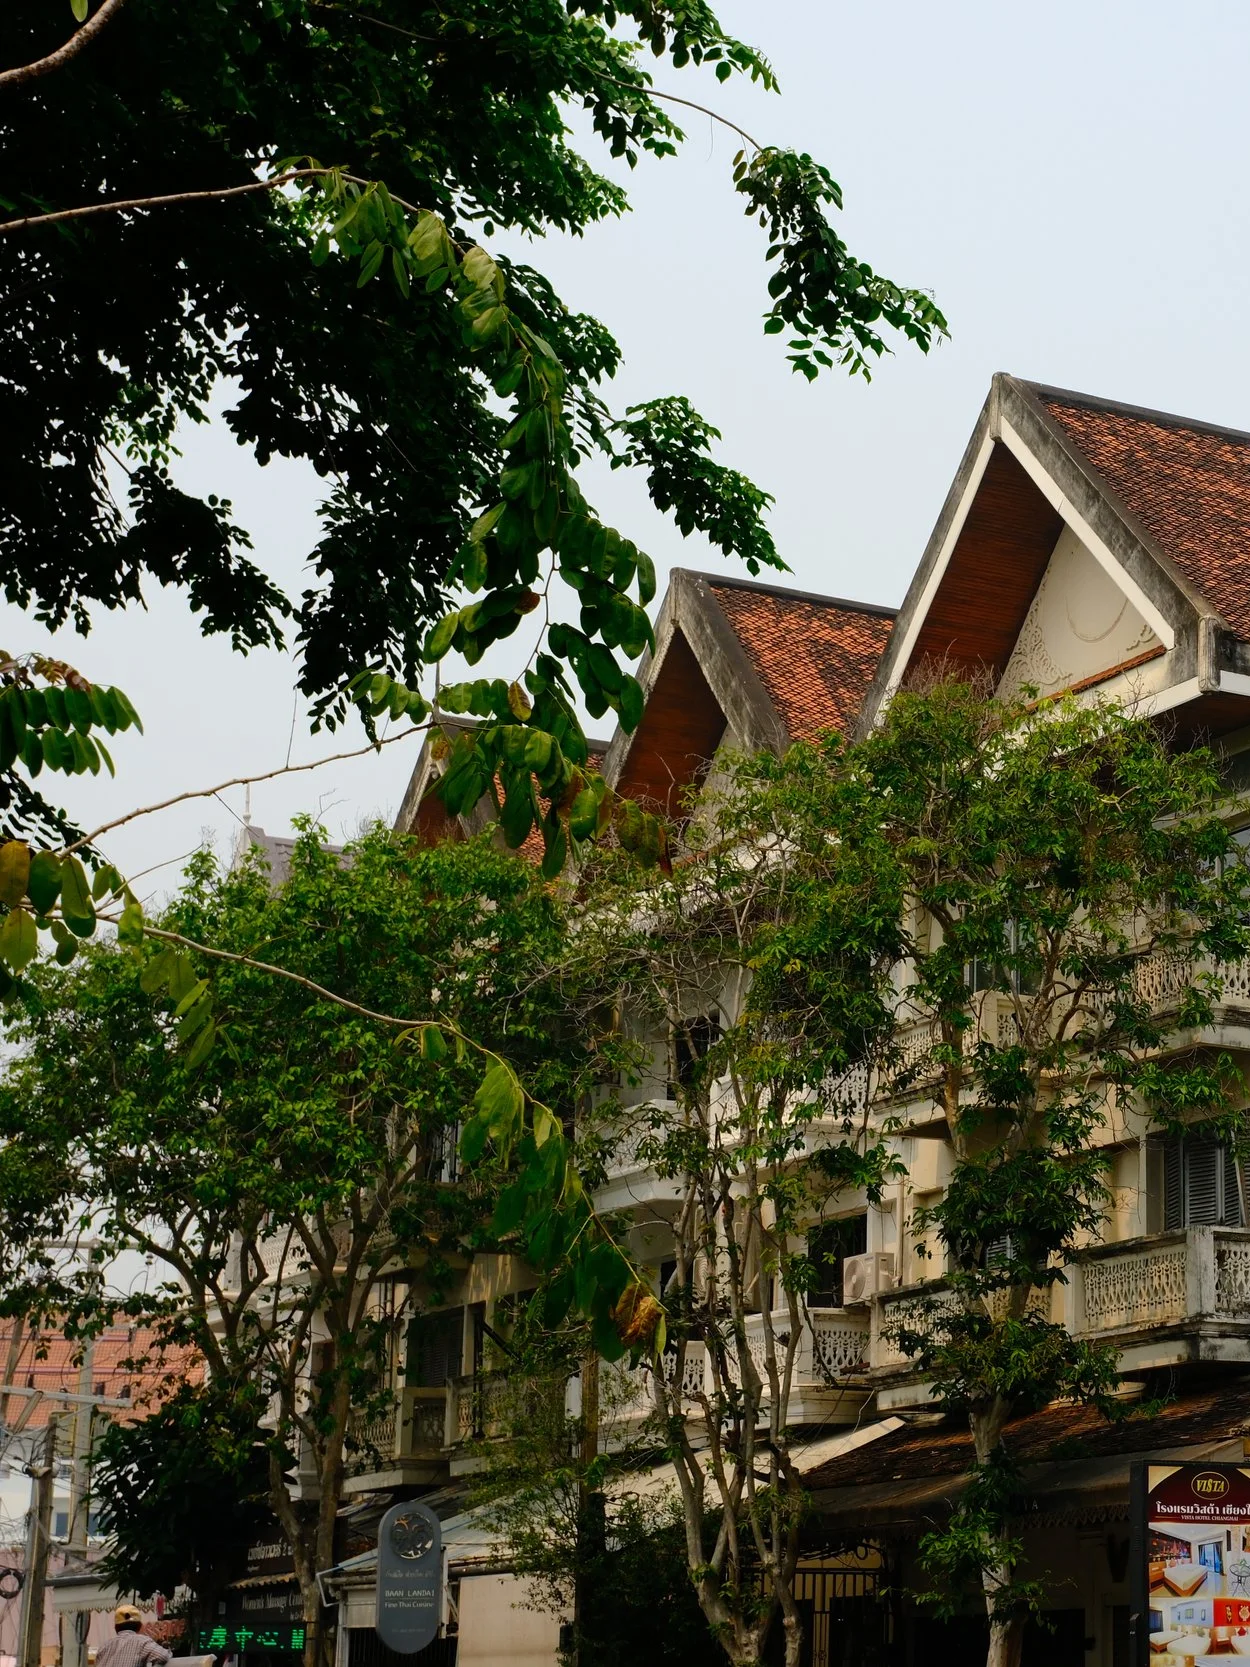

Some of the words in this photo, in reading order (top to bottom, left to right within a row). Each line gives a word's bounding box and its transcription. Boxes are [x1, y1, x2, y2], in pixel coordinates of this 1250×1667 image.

[1196, 1478, 1225, 1493] VISTA
[1156, 1501, 1220, 1515] โรงแรมวิสต้า
